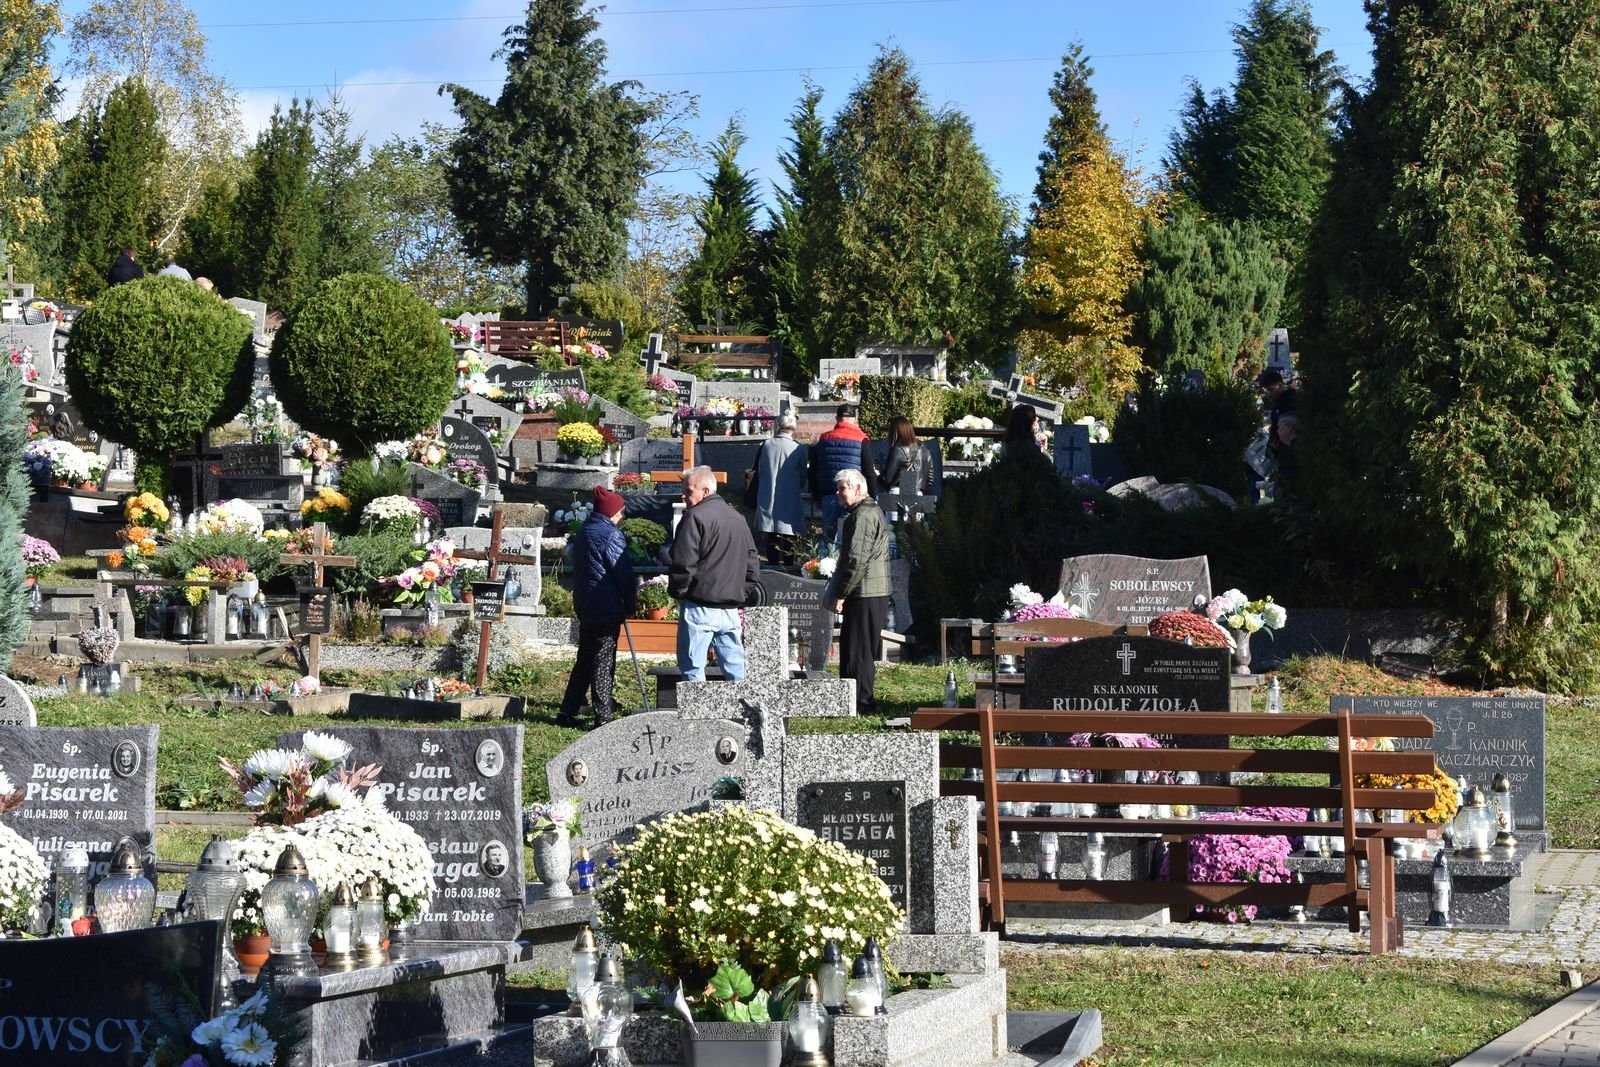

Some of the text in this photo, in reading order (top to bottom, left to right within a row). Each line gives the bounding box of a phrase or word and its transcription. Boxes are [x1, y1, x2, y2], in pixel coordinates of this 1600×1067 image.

[448, 442, 481, 451] Prokop
[1110, 580, 1195, 591] SOBOLEWSCY
[773, 591, 819, 600] BATOR
[1135, 595, 1169, 604] JÓZEF
[1052, 697, 1200, 712] RUDOLF ZIOŁA
[1393, 700, 1424, 709] WIERZY
[1427, 700, 1439, 708] WE
[1494, 701, 1509, 709] NIE
[1501, 711, 1513, 720] 26
[1466, 721, 1478, 733] P.
[62, 740, 82, 756] Śp.
[421, 738, 444, 757] Śp.
[631, 735, 672, 754] Ś P
[1394, 738, 1528, 752] SIĄDZ KANONIK
[1435, 753, 1536, 769] KACZMARCZYK
[31, 763, 112, 783] Eugenia
[408, 762, 452, 779] Jan
[615, 760, 697, 784] Kalisz
[24, 782, 119, 802] Pisarek
[379, 782, 487, 802] Pisarek
[844, 788, 871, 801] Ś P
[582, 796, 631, 815] Adela
[23, 809, 128, 820] 01.04.1930 07.01.2021
[444, 809, 501, 821] 23.07.2019
[823, 812, 895, 824] WŁADYSŁAW
[821, 825, 897, 840] BISAGA
[423, 837, 479, 855] sław
[430, 861, 480, 883] aga
[444, 887, 501, 899] 05.03.1982
[412, 910, 495, 925] fam Tobie
